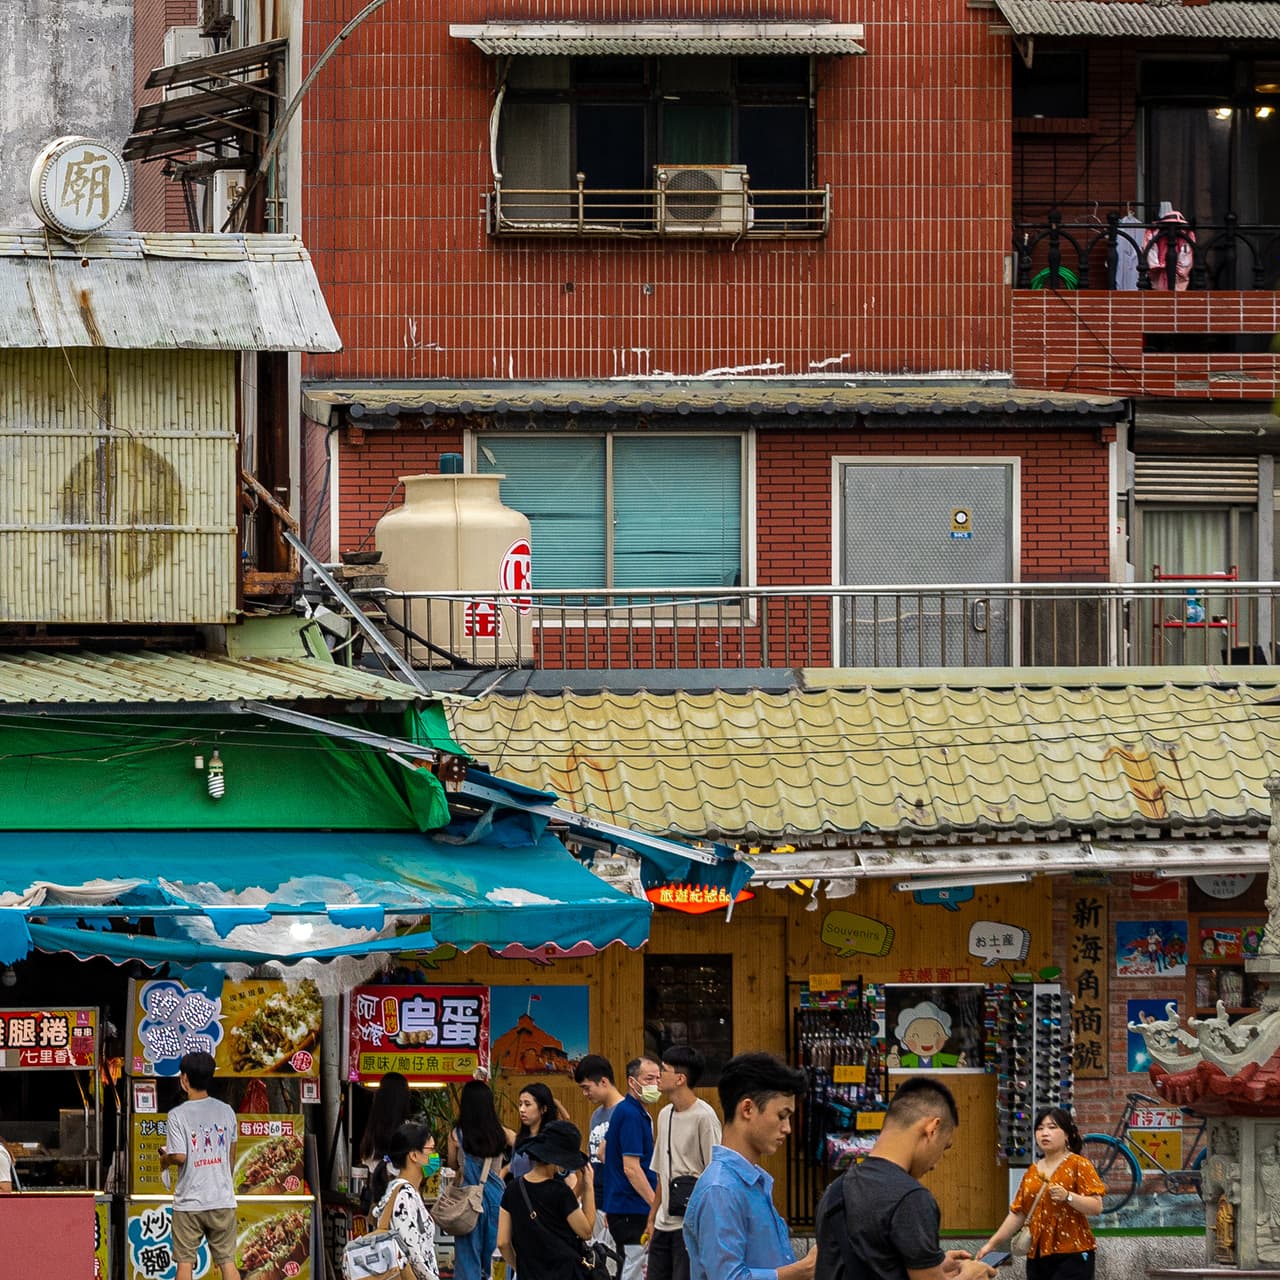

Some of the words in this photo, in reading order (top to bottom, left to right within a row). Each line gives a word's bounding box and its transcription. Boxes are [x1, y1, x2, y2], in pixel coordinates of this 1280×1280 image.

[60, 151, 112, 219] 廟
[826, 923, 880, 941] Souvenirs
[975, 933, 1015, 949] お土産
[1072, 896, 1105, 1070] 新海角商號
[457, 1059, 472, 1067] 25
[193, 1156, 222, 1169] ULTRAMAN
